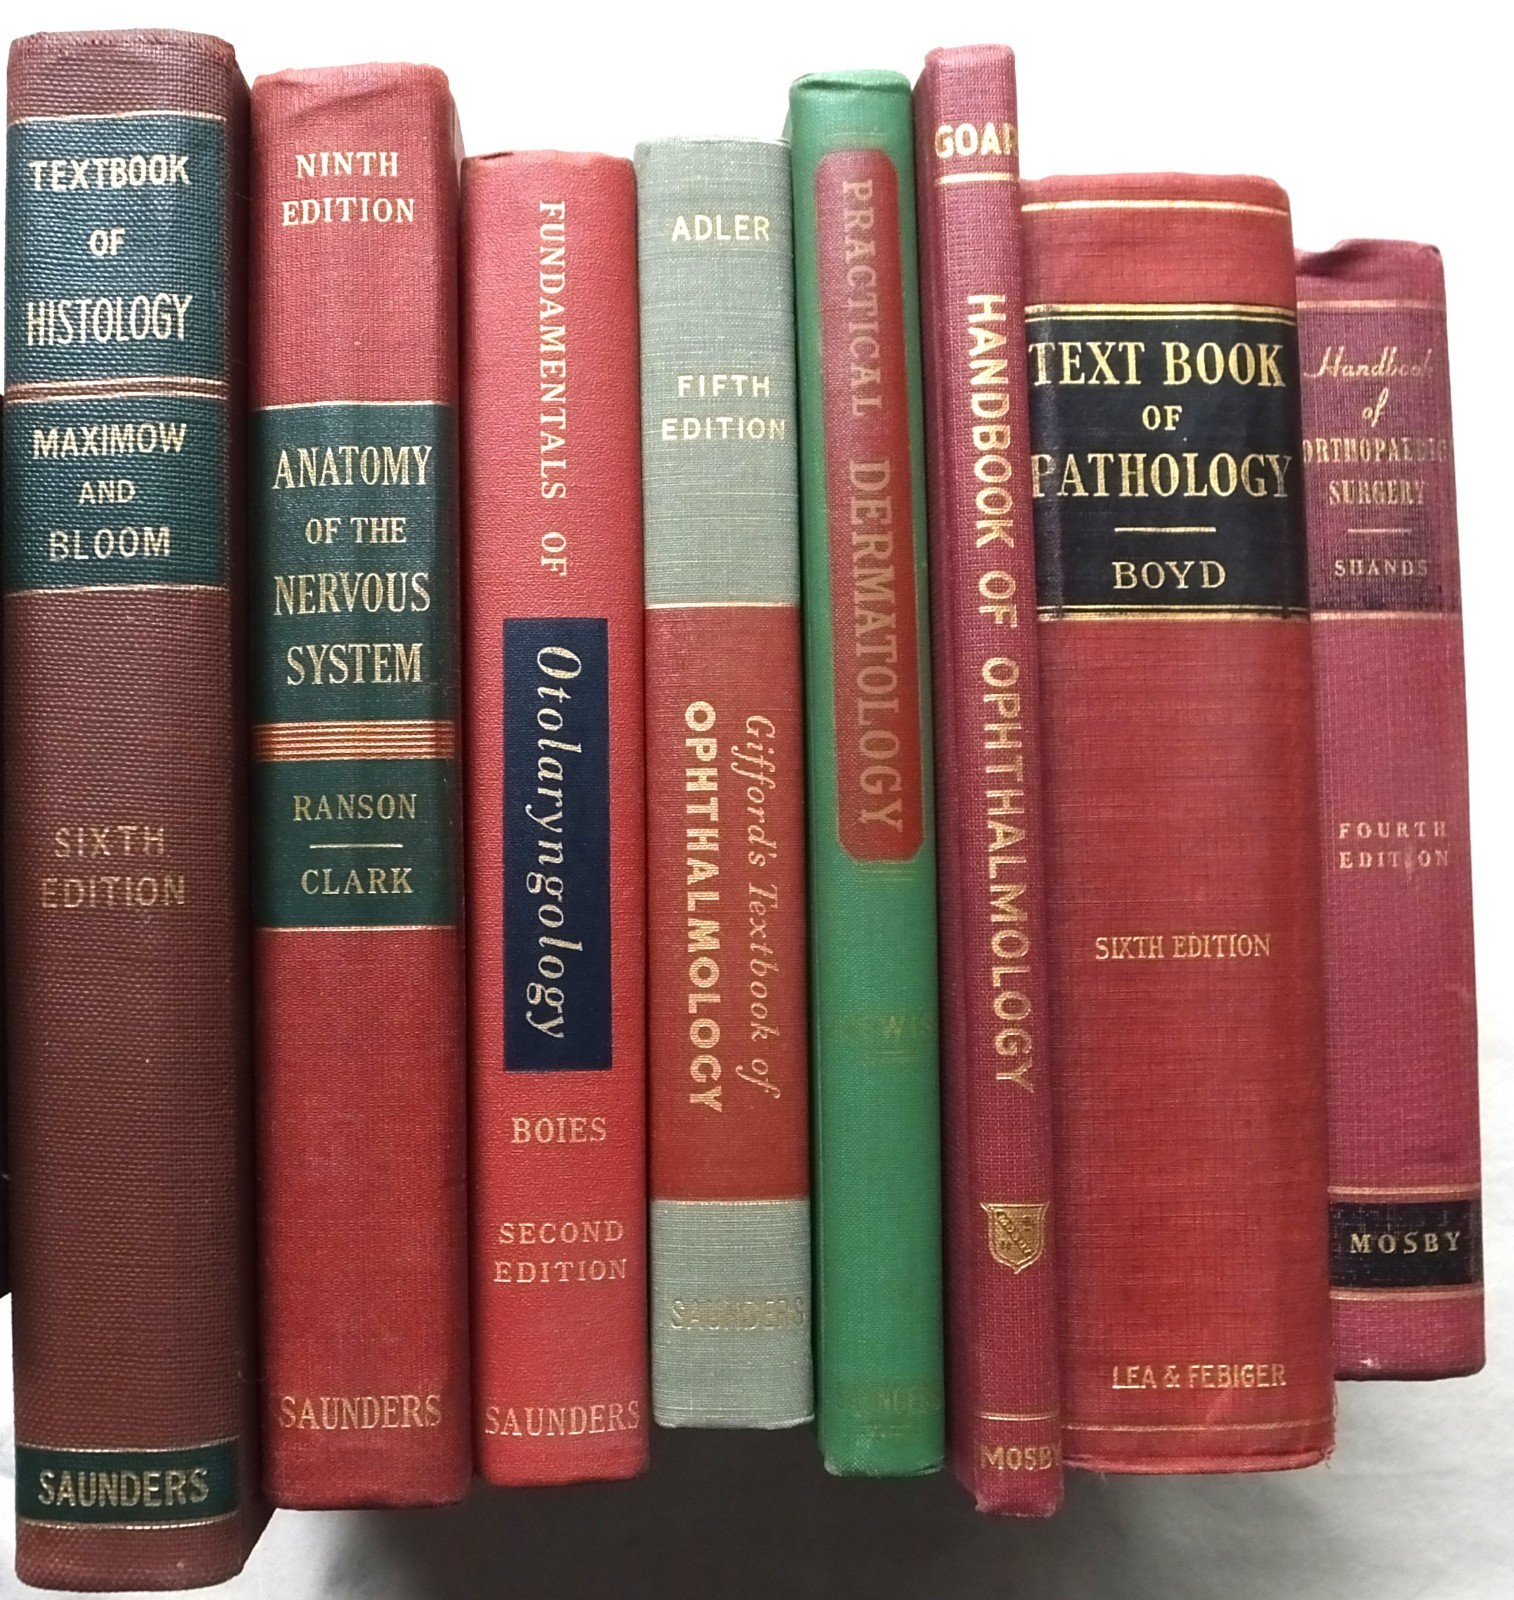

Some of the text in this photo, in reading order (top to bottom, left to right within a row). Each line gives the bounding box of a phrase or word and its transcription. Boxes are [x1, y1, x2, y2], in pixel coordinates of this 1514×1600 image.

[31, 154, 190, 192] TEXTBOOK
[296, 151, 399, 180] NINTH
[282, 198, 415, 227] EDITION
[89, 229, 125, 256] OF
[672, 215, 771, 242] ADLER
[27, 294, 192, 347] HISTOLOGY
[1028, 341, 1286, 387] TEXT BOOK
[539, 199, 567, 577] FUNDAMENTALS OF
[677, 374, 771, 399] FIFTH
[1142, 405, 1183, 431] OF
[1361, 387, 1390, 429] of
[32, 423, 187, 459] MAXIMOW
[660, 416, 787, 441] EDITION
[273, 445, 433, 489] ANATOMY
[1031, 452, 1292, 498] PATHOLOGY
[79, 480, 137, 506] AND
[843, 179, 905, 832] PRACTICAL DERMATOLOGY
[1329, 479, 1425, 506] SURGERY
[49, 527, 171, 562] BLOOM
[305, 517, 408, 545] OF THE
[1112, 561, 1227, 591] BOYD
[1334, 558, 1429, 578] SHANDS
[273, 571, 431, 616] NERVOUS
[286, 642, 423, 687] SYSTEM
[966, 294, 1035, 1094] HANDBOOK OF OPHTHALMOLOGY
[293, 794, 418, 822] RANSON
[54, 825, 166, 858] SIXTH
[525, 646, 584, 1038] Otolaryngology
[1339, 821, 1447, 839] FOURTH
[41, 874, 186, 909] EDITION
[301, 867, 414, 895] CLARK
[684, 700, 723, 1113] OPHTHALMOLOGY
[730, 714, 781, 1100] Gifford's Textbook of
[1095, 932, 1271, 961] SIXTH EDITION
[511, 1117, 607, 1145] BOIES
[499, 1220, 625, 1246] SECOND
[1350, 1233, 1461, 1255] MOSBY
[493, 1257, 628, 1284] EDITION
[1112, 1365, 1286, 1390] LEA & FEBIGER
[279, 1395, 441, 1431] SAUNDERS
[485, 1402, 641, 1437] SAUNDERS
[37, 1469, 210, 1507] SAUNDERS
